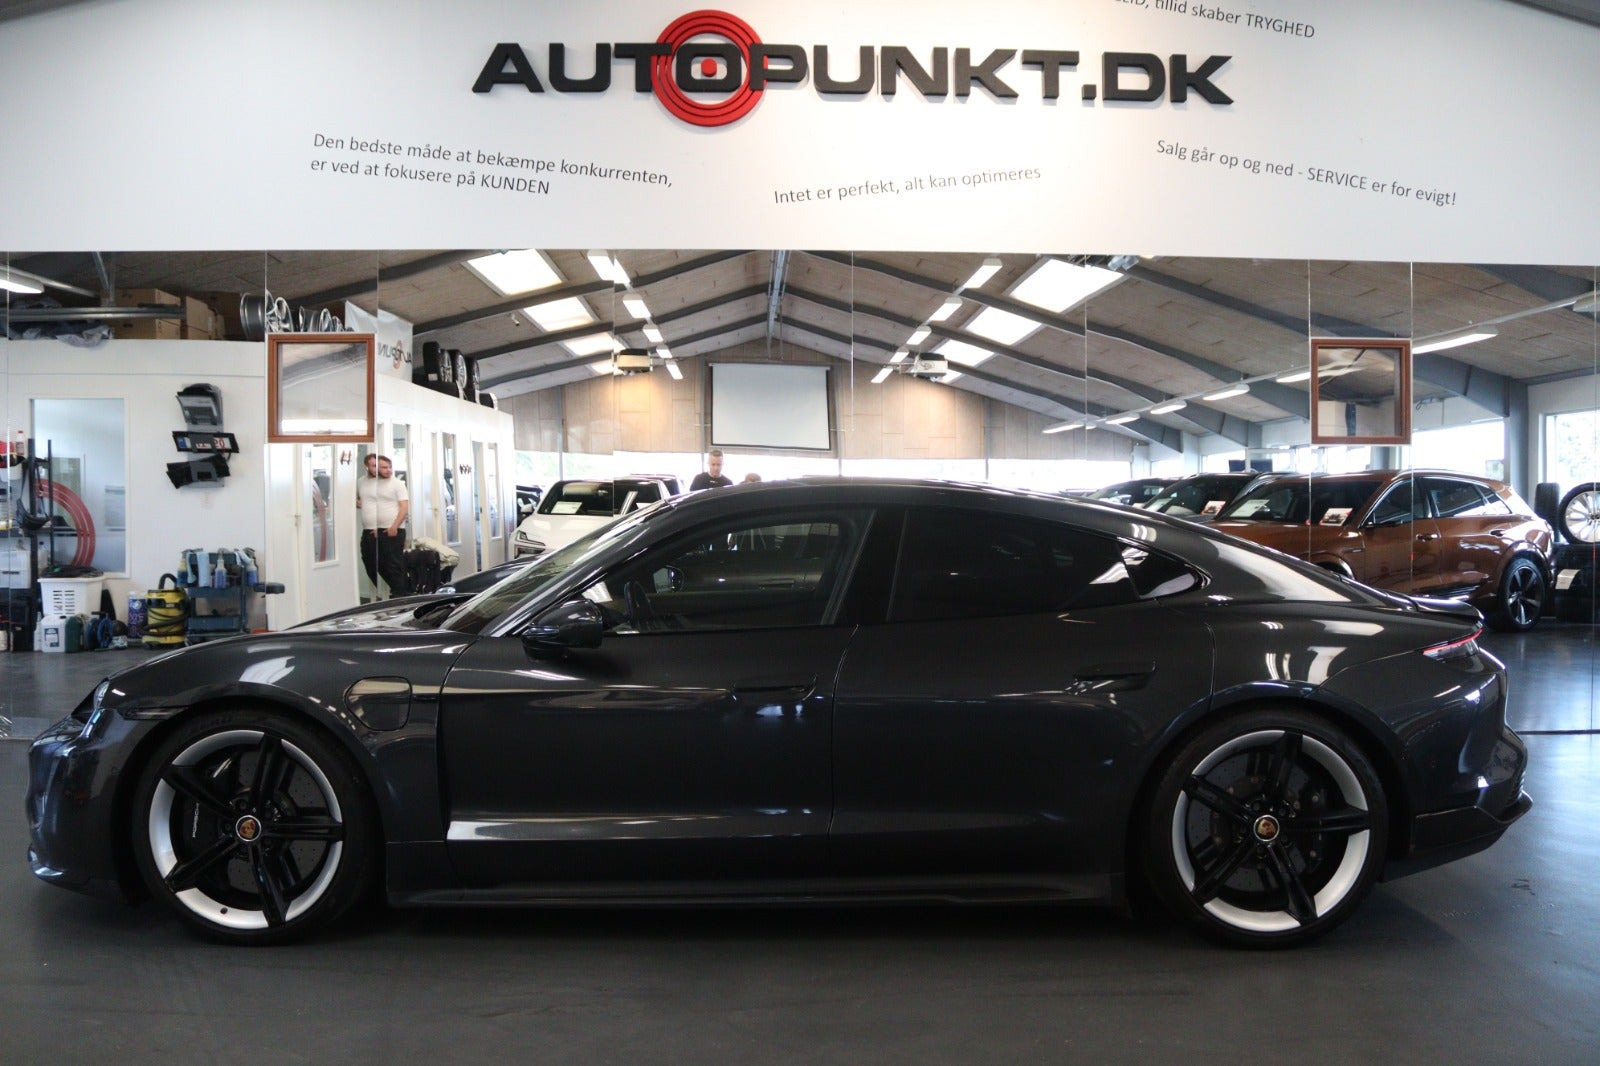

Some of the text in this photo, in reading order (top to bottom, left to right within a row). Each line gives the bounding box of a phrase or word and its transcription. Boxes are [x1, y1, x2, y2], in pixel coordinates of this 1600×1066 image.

[1154, 0, 1187, 14] tillid
[1191, 3, 1242, 25] skaber
[1245, 12, 1315, 39] TRYGHED
[472, 42, 1234, 105] AUTOPUNKT.DK
[310, 157, 550, 195] er ved at fokusere på KUNDEN
[313, 133, 673, 189] Den bedste måde at bekæmpe konkurrenten,
[1156, 139, 1188, 160] Salg
[1190, 146, 1217, 164] går
[1219, 153, 1239, 169] op
[1242, 158, 1261, 175] og
[1265, 159, 1294, 177] ned
[1307, 167, 1368, 191] SERVICE
[1371, 180, 1388, 193] er
[1391, 180, 1413, 198] for
[1415, 188, 1457, 208] evigt!
[774, 166, 1042, 205] Intet er perfekt, alt kan optimeres
